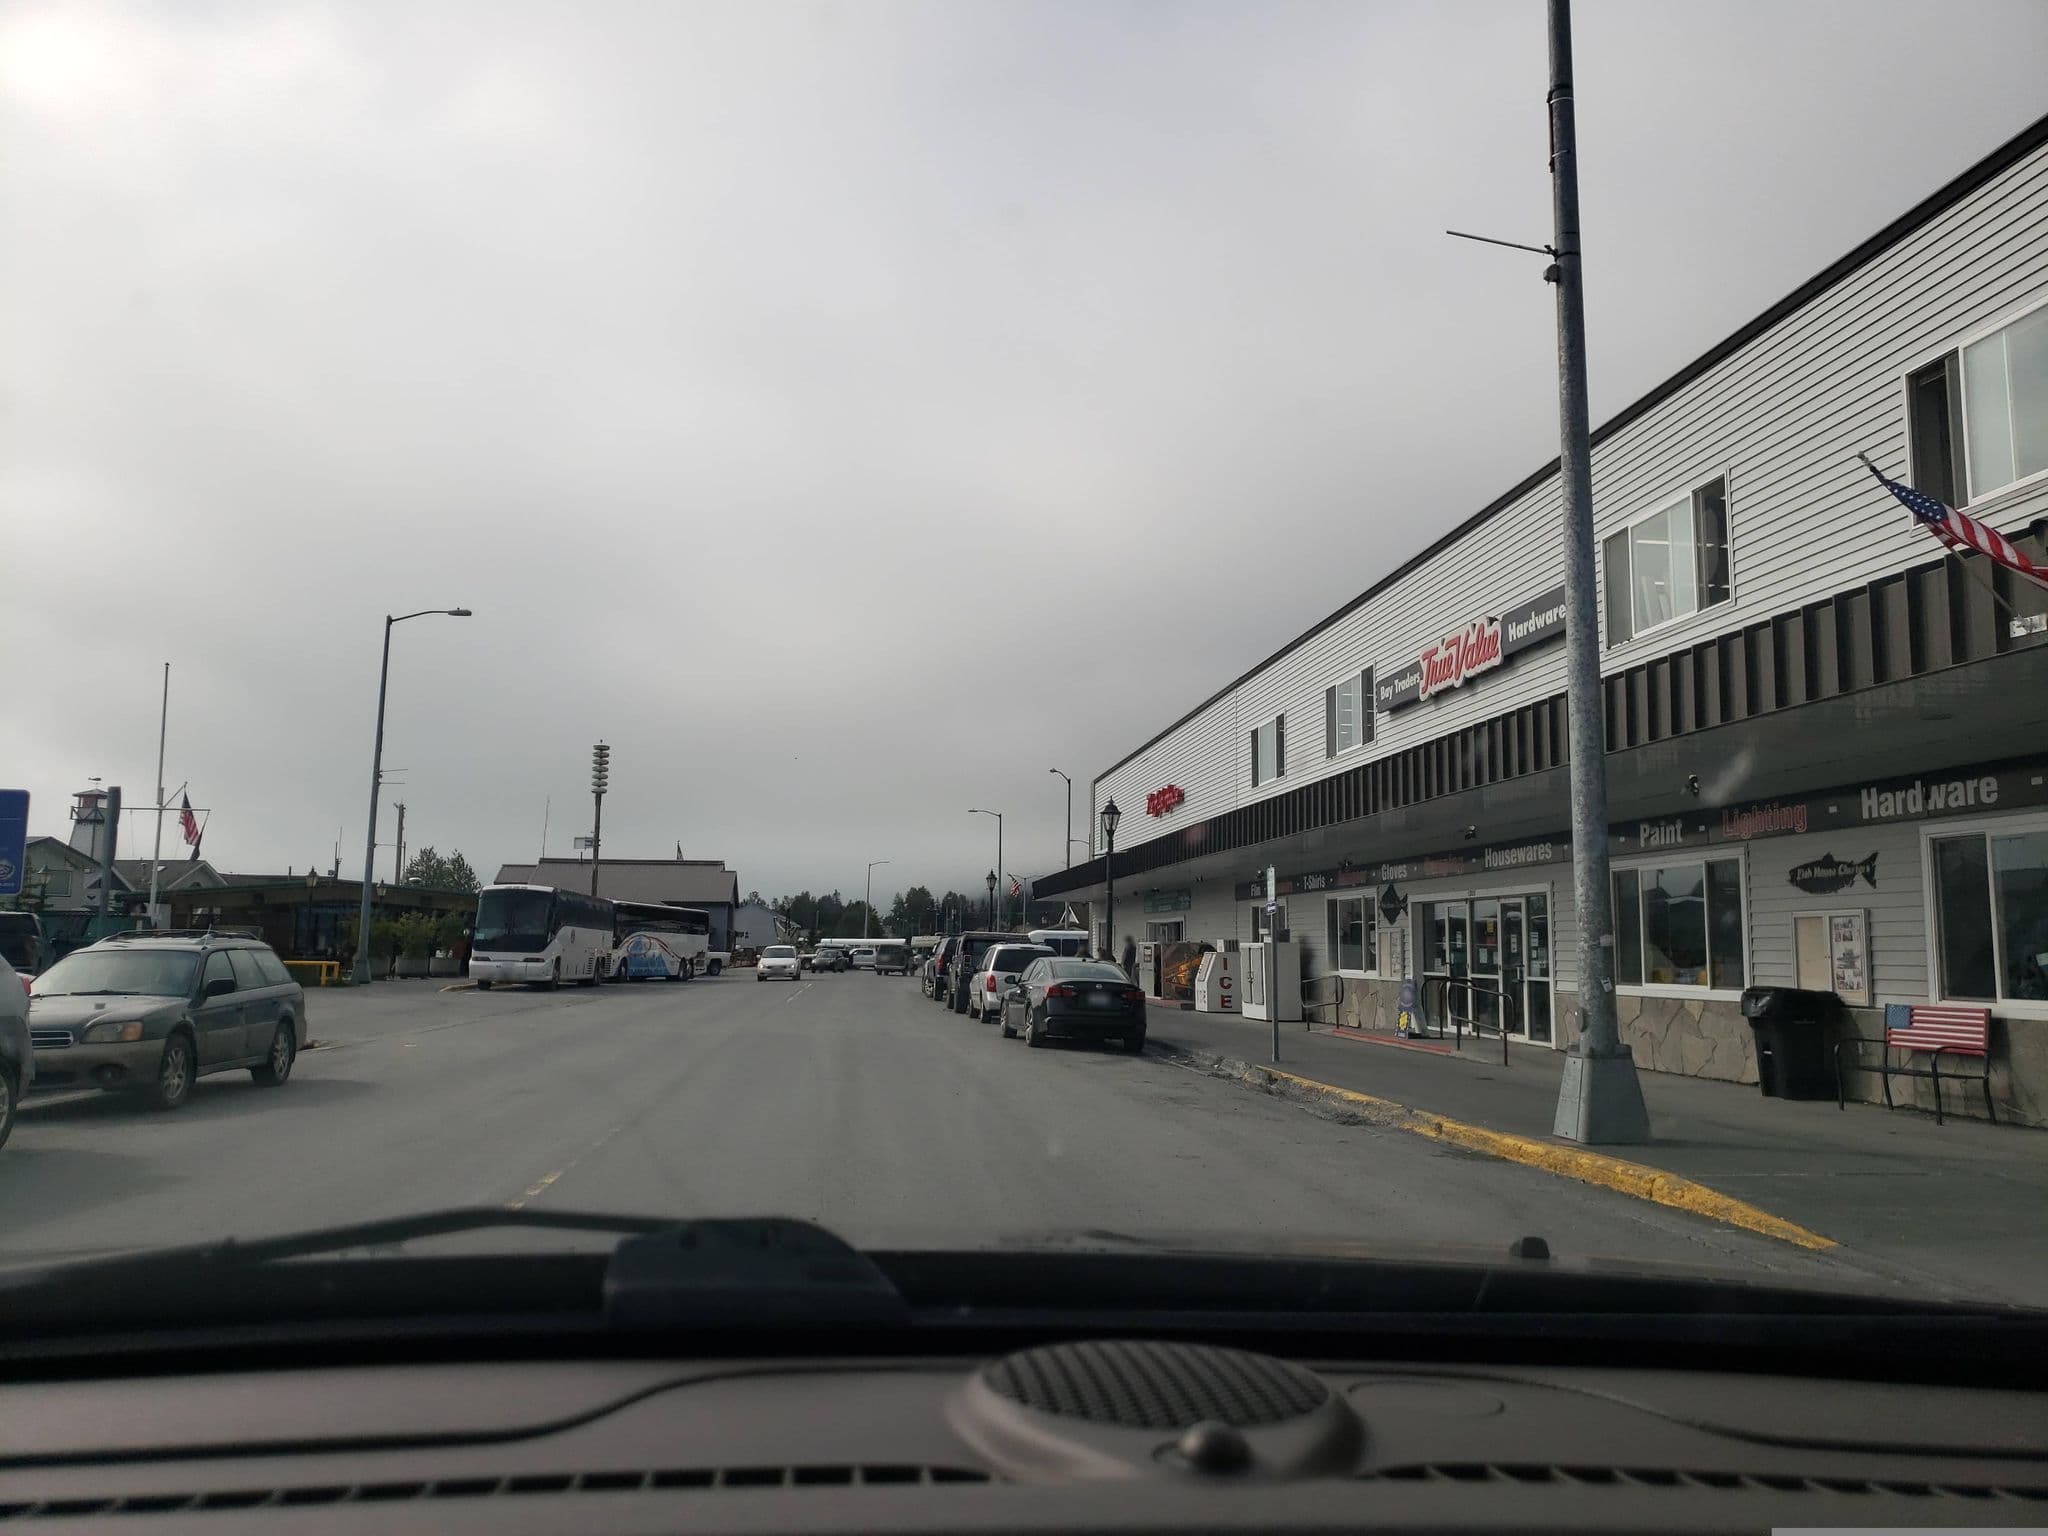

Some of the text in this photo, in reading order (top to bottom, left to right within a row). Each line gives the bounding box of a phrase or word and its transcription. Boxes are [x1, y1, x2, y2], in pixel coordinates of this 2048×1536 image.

[1508, 603, 1566, 642] Hardware
[1421, 622, 1500, 695] True Value
[1380, 671, 1420, 700] Bay Traders
[1860, 776, 1999, 820] Hardware
[1639, 820, 1683, 848] Paint
[1722, 802, 1808, 839] Lighting
[1381, 863, 1408, 881] Gloves
[1484, 841, 1553, 868] Housewares
[1219, 957, 1233, 1009] ICE
